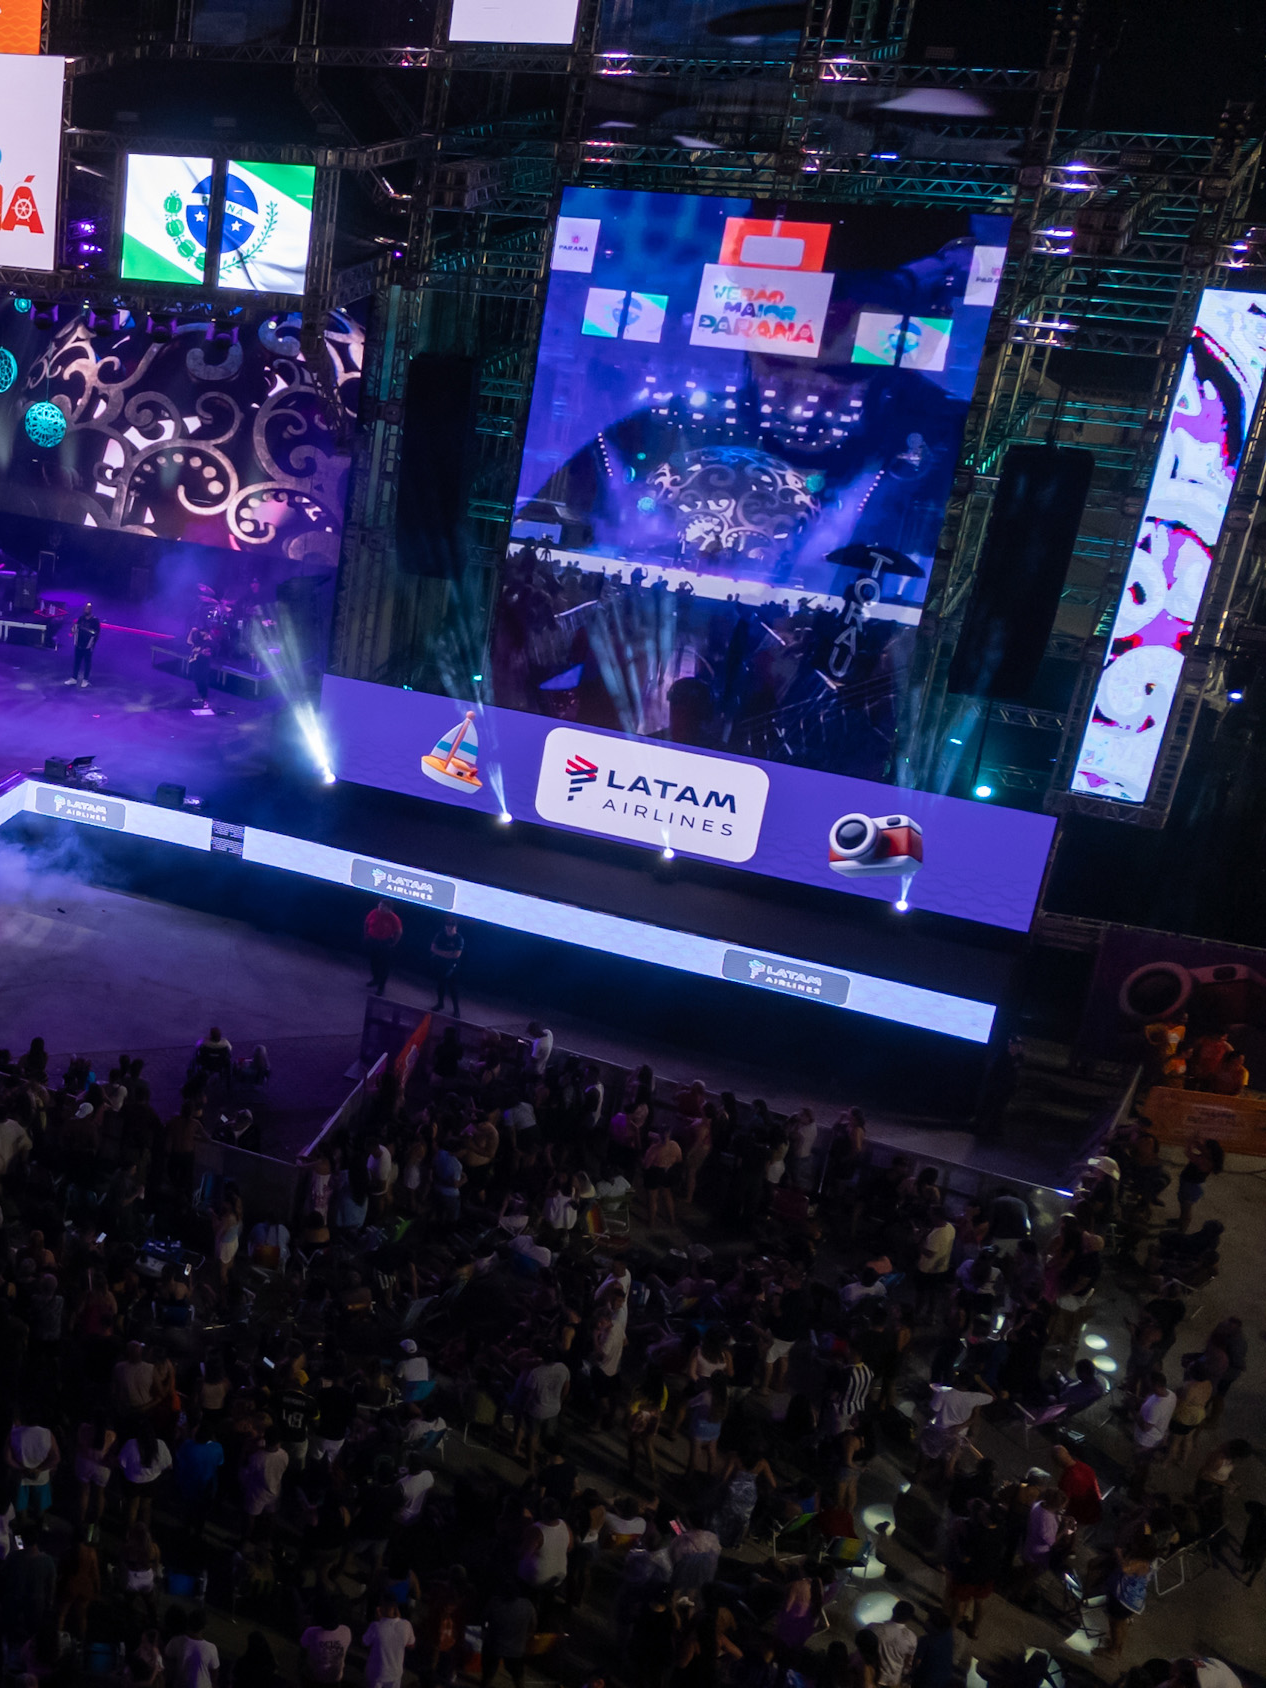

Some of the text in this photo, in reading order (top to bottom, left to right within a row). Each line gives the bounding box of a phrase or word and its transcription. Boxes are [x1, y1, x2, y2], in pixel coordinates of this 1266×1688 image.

[698, 314, 815, 344] PARANÁ
[607, 769, 737, 814] LATAM
[66, 799, 107, 815] LATAM
[602, 798, 734, 836] AIRLINES
[386, 874, 433, 893] LATAM
[386, 884, 432, 901] AIRLINES
[765, 976, 821, 995] AIRLINES
[766, 965, 822, 987] LATAM
